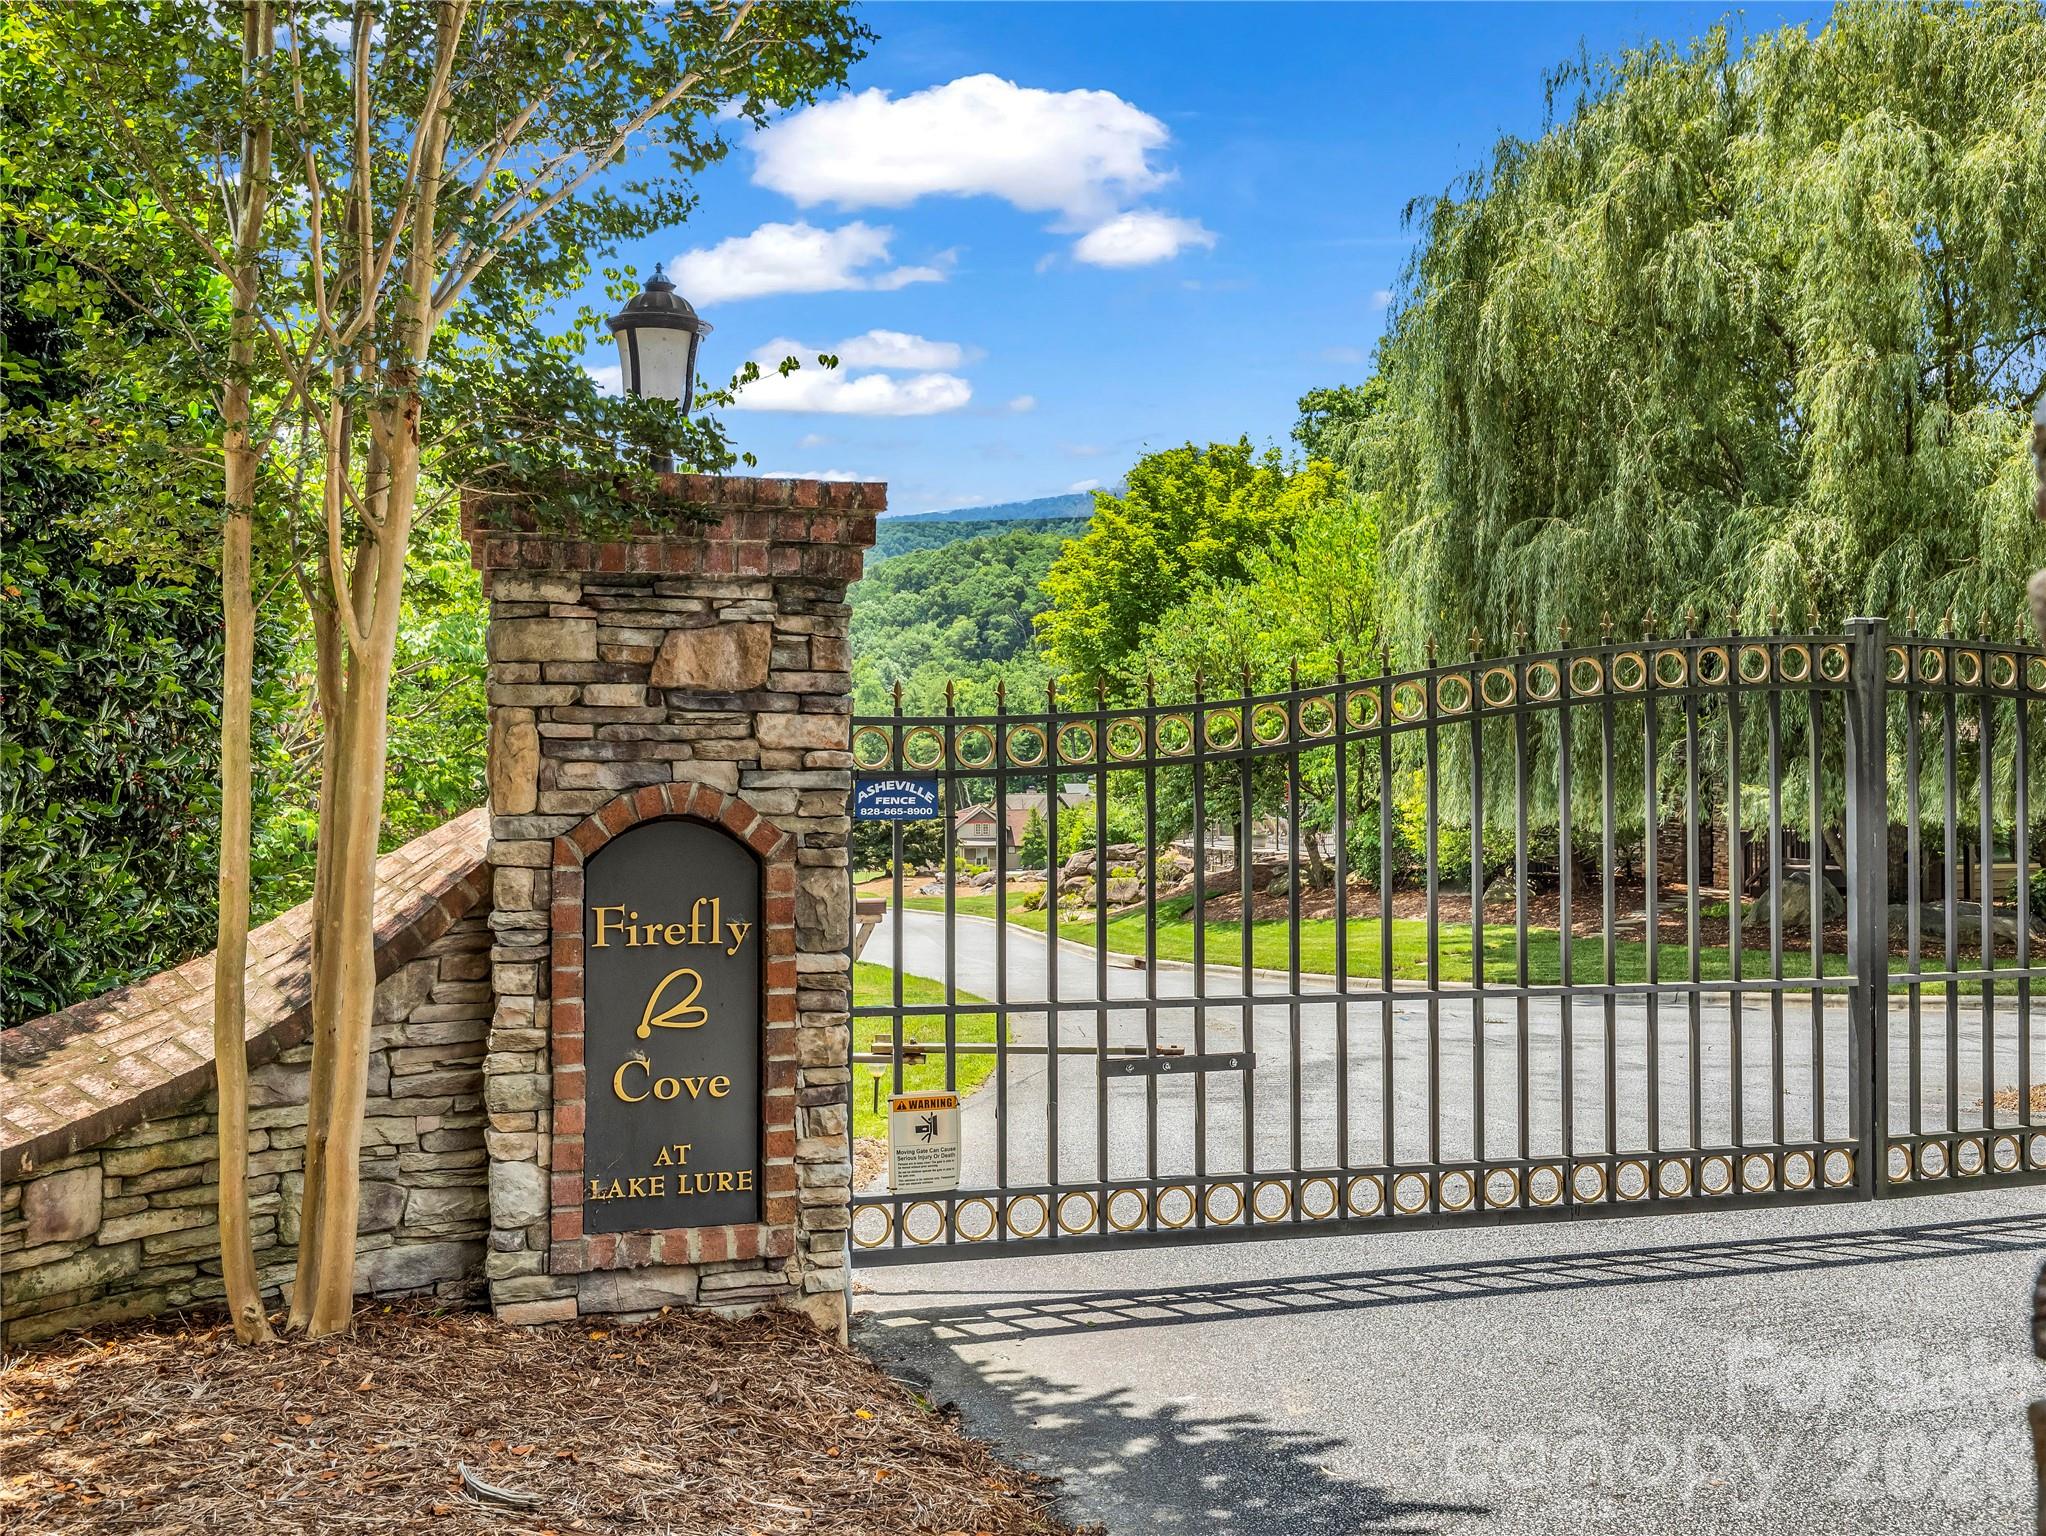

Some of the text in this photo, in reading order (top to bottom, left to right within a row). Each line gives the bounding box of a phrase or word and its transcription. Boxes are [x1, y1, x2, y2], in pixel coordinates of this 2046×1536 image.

[858, 780, 935, 803] ASHEVILLE
[875, 796, 916, 804] FENCE
[860, 807, 933, 815] 828-665-8900
[591, 897, 752, 956] Firefly
[613, 1057, 731, 1102] Cove
[908, 1098, 952, 1109] WARNING
[653, 1144, 692, 1167] AT
[590, 1169, 753, 1200] LAKE LURE
